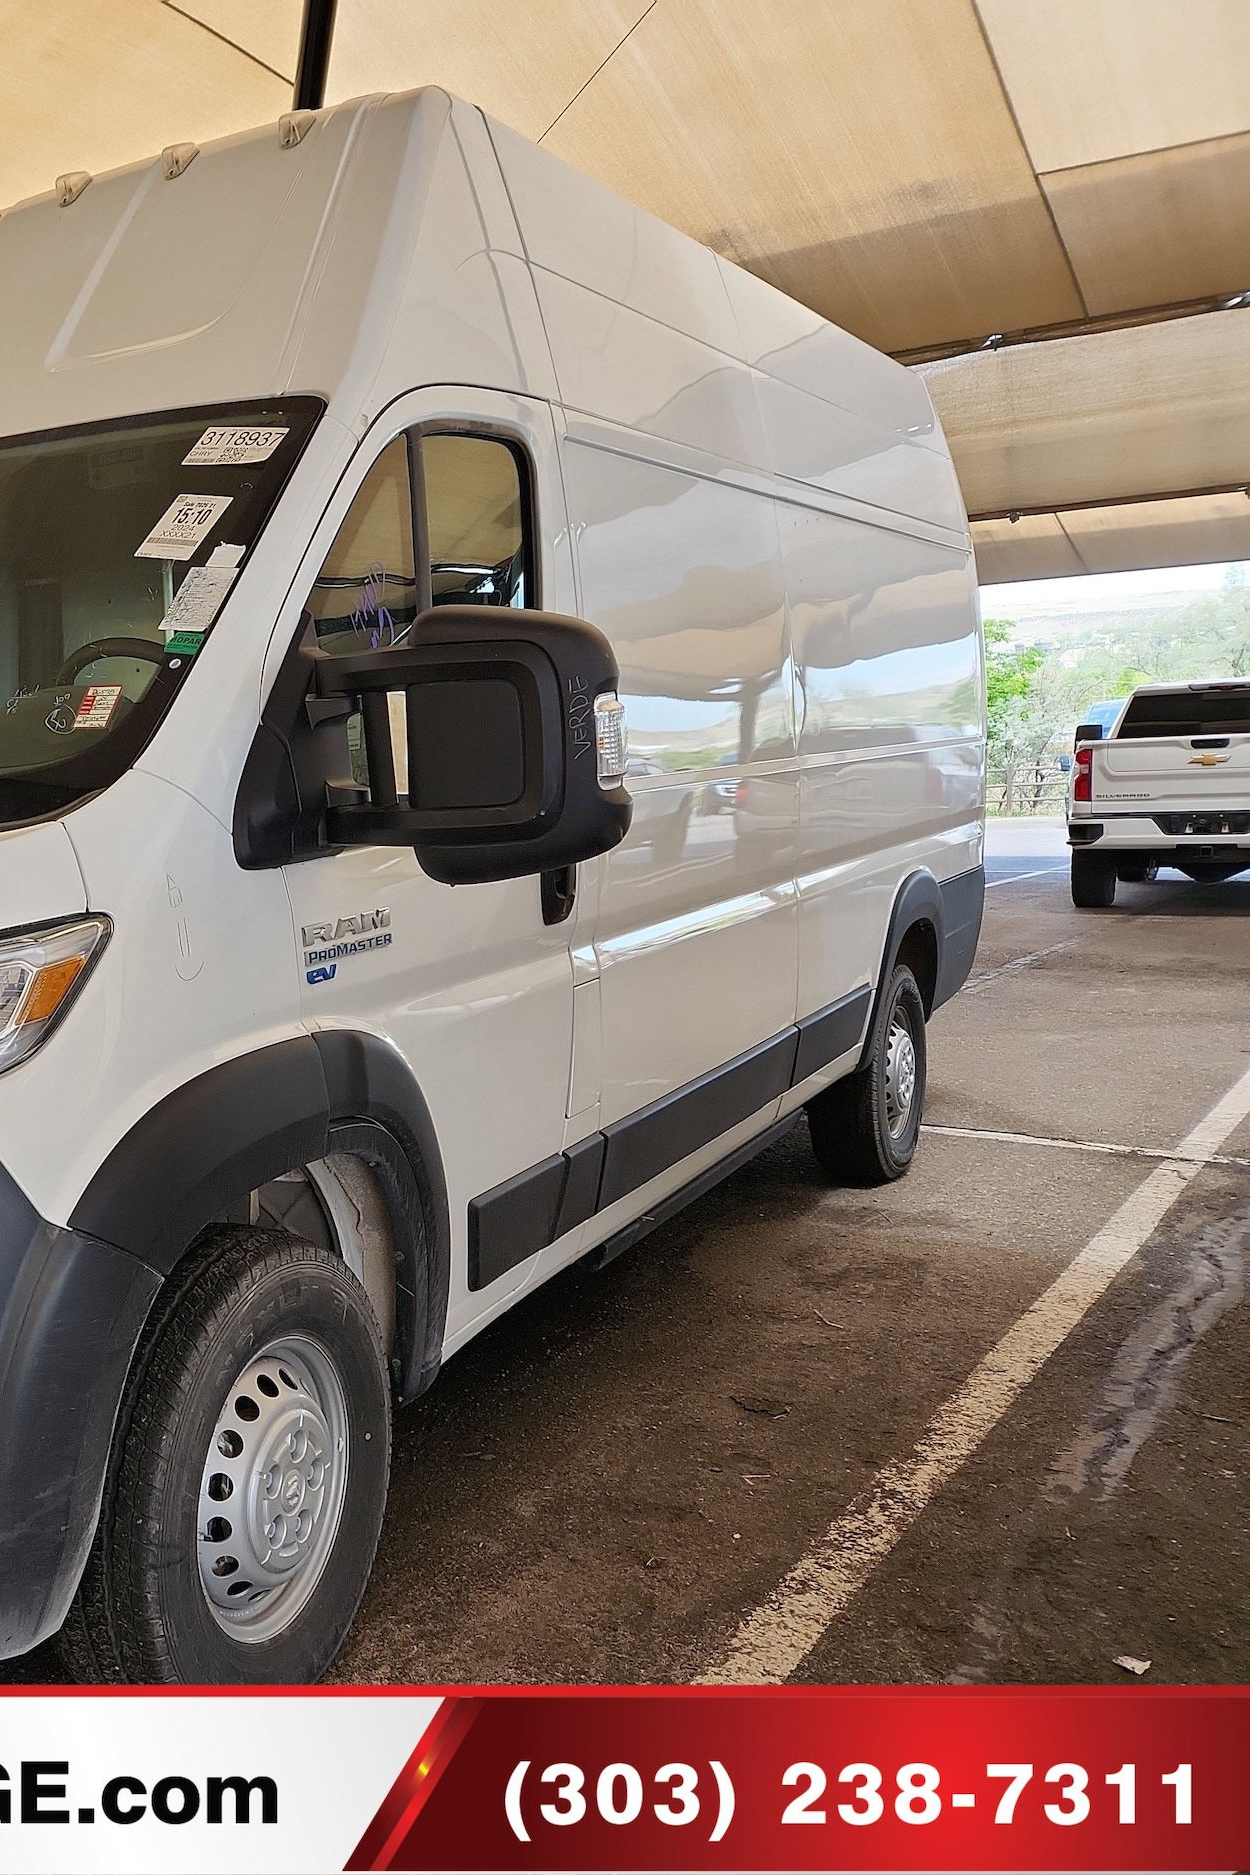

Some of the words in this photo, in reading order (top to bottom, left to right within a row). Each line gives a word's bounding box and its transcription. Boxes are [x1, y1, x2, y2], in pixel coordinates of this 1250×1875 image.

[201, 431, 286, 447] 3118937
[172, 507, 213, 525] 15:10
[171, 524, 195, 532] 2024
[169, 636, 202, 645] MOPAR
[301, 906, 392, 947] RAM
